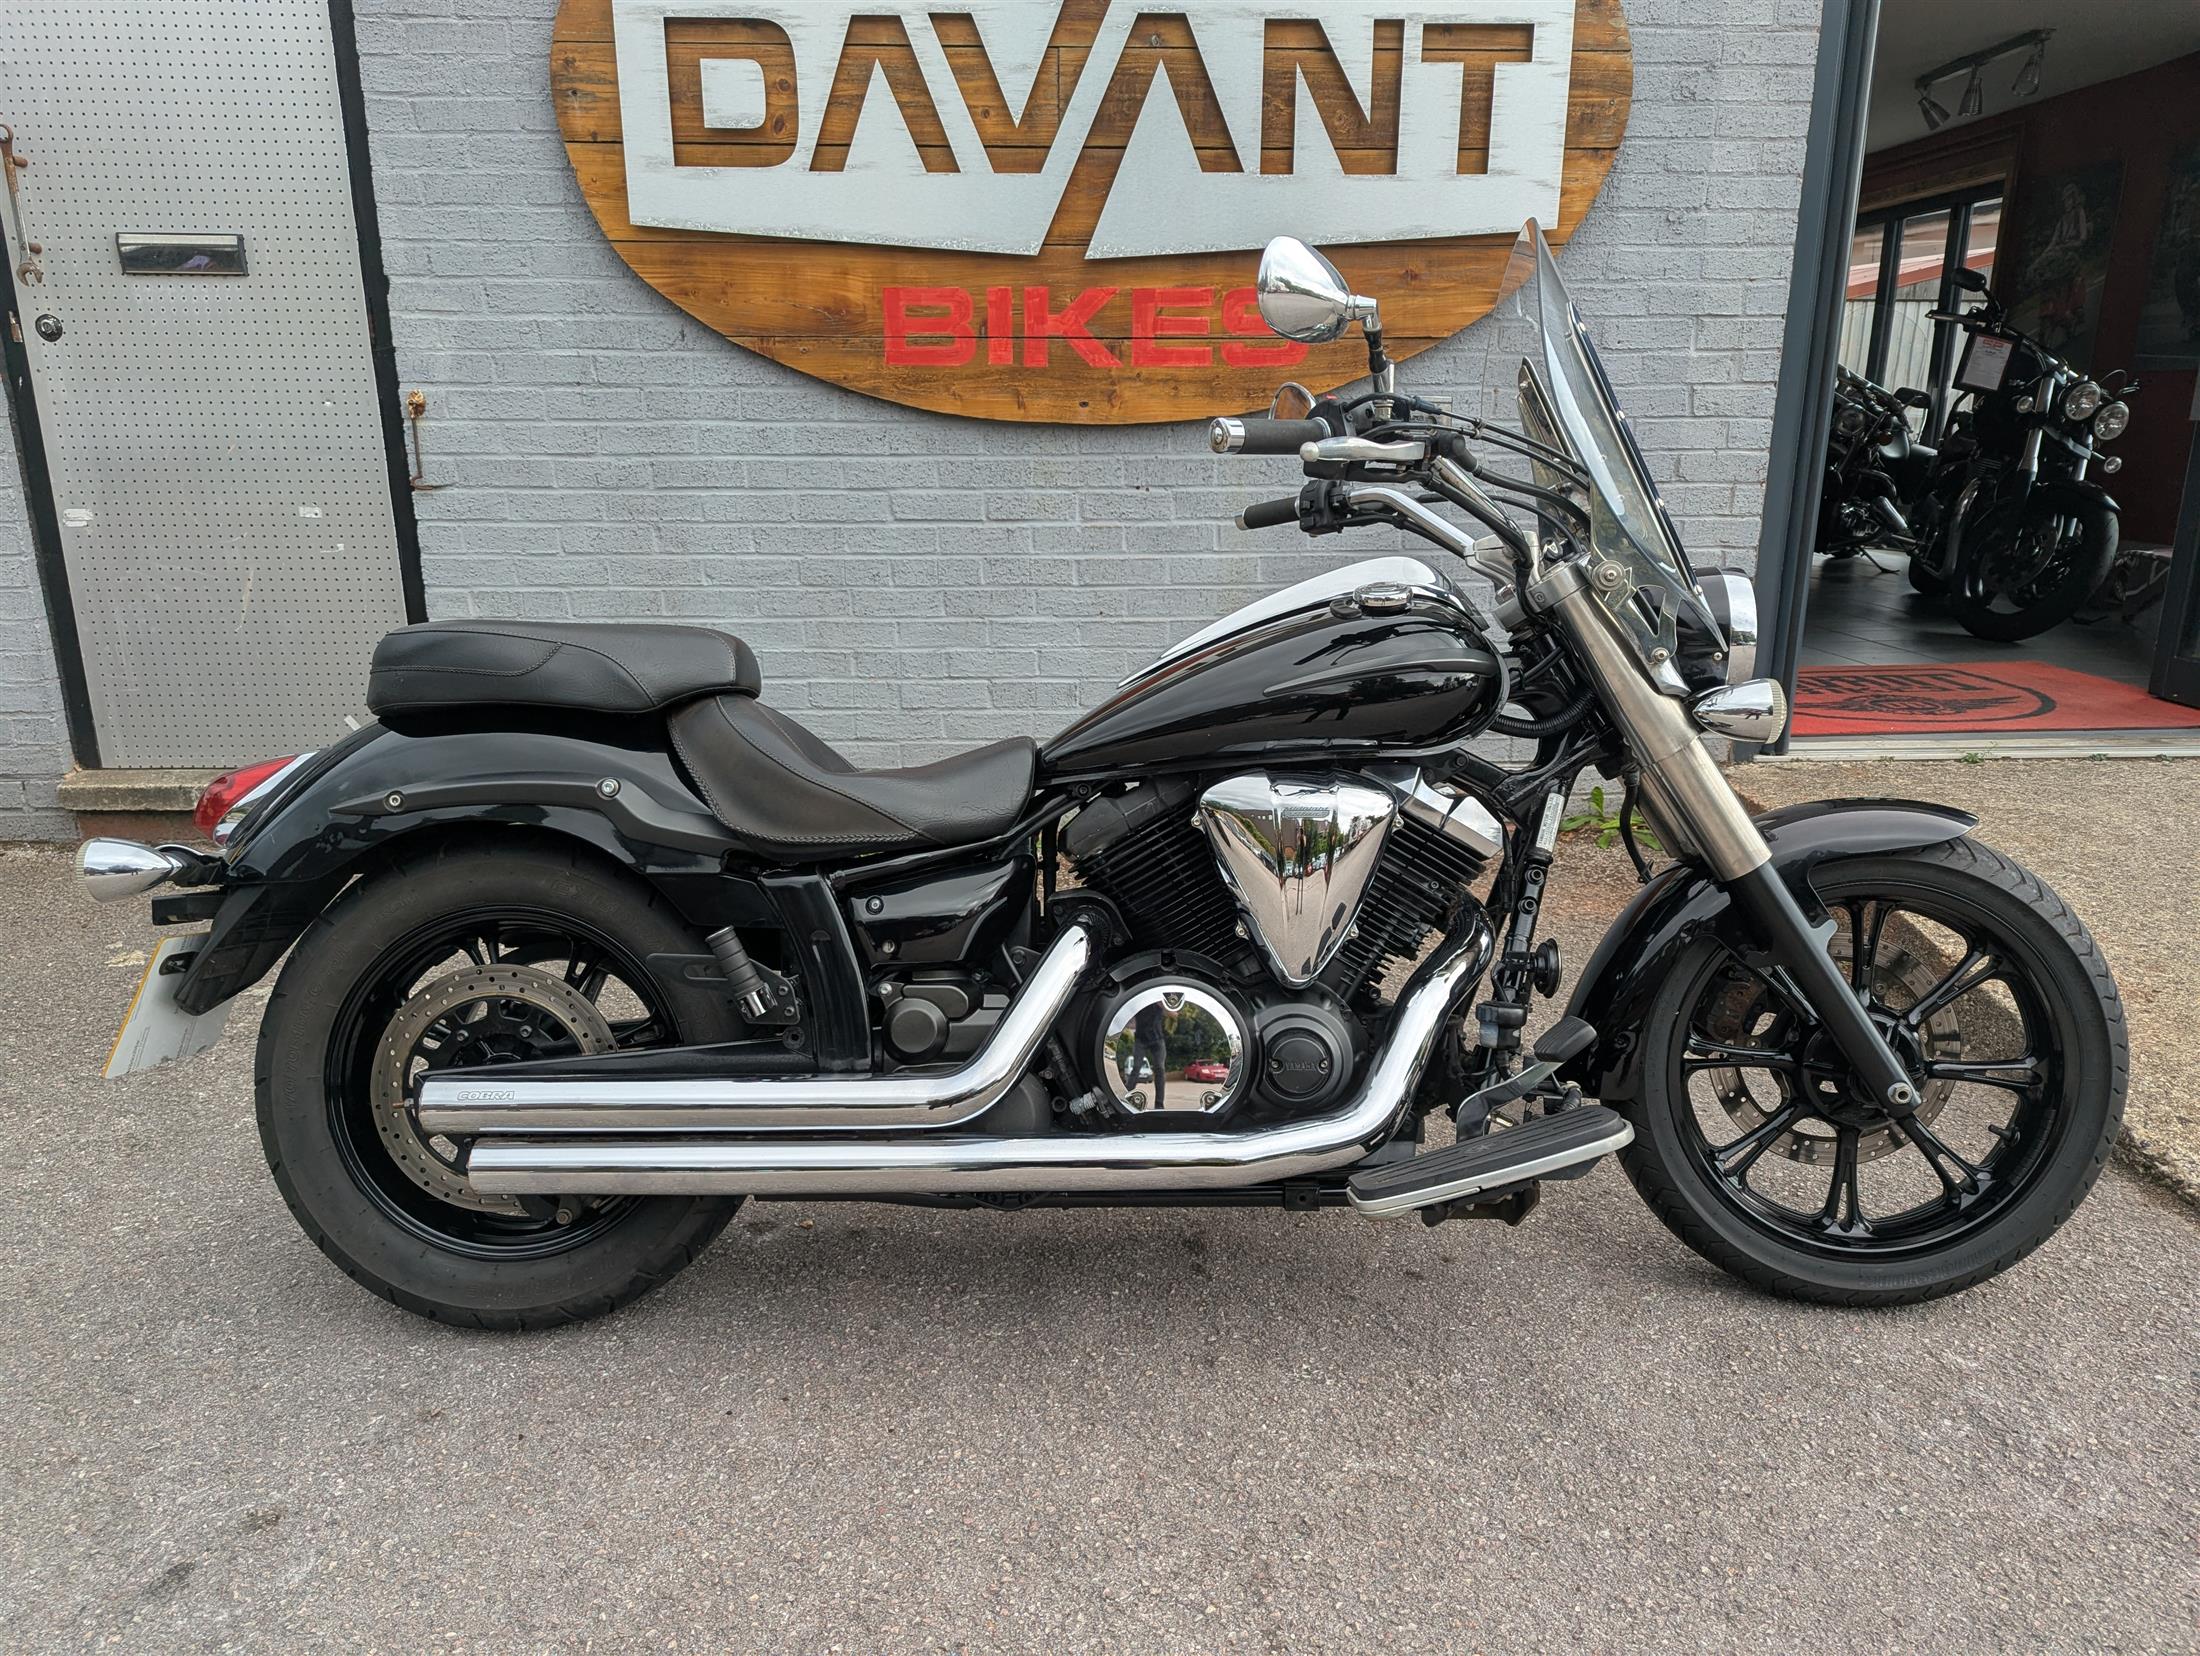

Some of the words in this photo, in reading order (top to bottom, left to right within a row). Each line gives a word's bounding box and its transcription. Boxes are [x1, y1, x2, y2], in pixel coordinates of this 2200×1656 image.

[663, 9, 1535, 178] DAVANT
[882, 286, 1309, 368] BIKES
[1284, 1060, 1318, 1071] YAMAHA
[457, 1090, 516, 1101] COBRA
